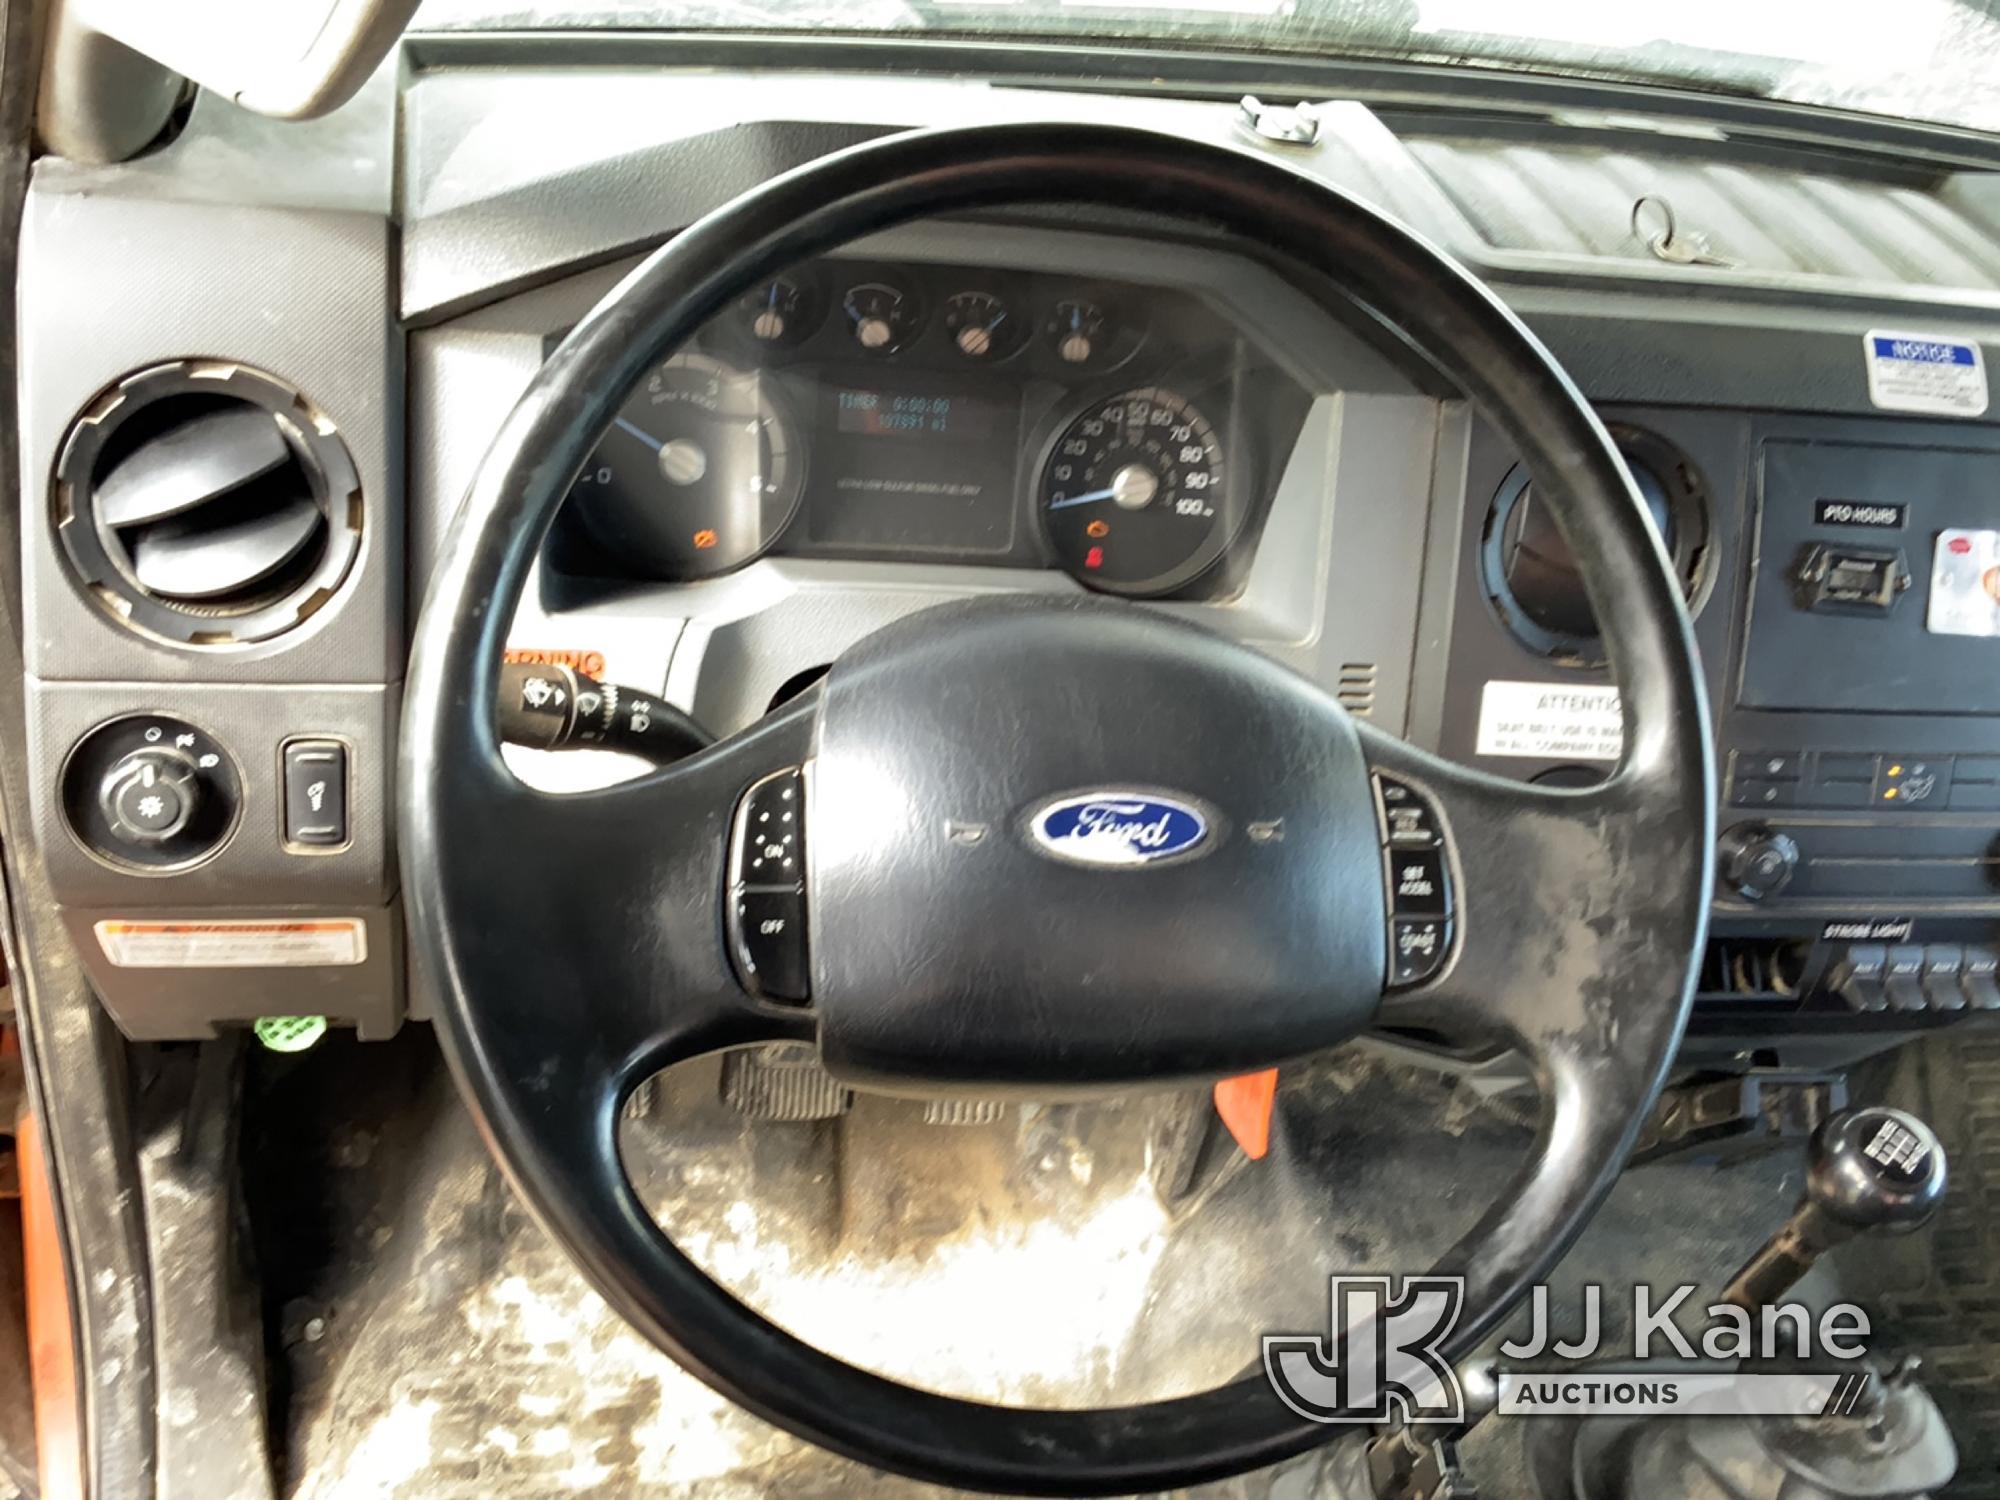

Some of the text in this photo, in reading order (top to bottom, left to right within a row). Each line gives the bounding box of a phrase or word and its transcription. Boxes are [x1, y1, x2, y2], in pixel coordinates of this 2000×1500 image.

[1891, 341, 1957, 362] NOTICE
[1101, 406, 1124, 422] 40
[1151, 409, 1173, 426] 60
[1081, 419, 1104, 436] 30
[1170, 425, 1191, 442] 70
[1063, 439, 1088, 456] 20
[1179, 445, 1203, 463] 80
[597, 467, 612, 484] 0
[1054, 464, 1073, 481] 10
[1185, 472, 1209, 489] 90
[1175, 498, 1204, 516] 100
[1823, 504, 1898, 525] PTO HOURS
[1537, 693, 1623, 714] ATTENTIO
[1070, 802, 1172, 848] Ford
[764, 844, 785, 859] ON
[1401, 865, 1425, 881] SET
[1398, 880, 1433, 896] ACCEL
[760, 918, 785, 934] OFF
[1823, 922, 1907, 939] STROBE LIGHT
